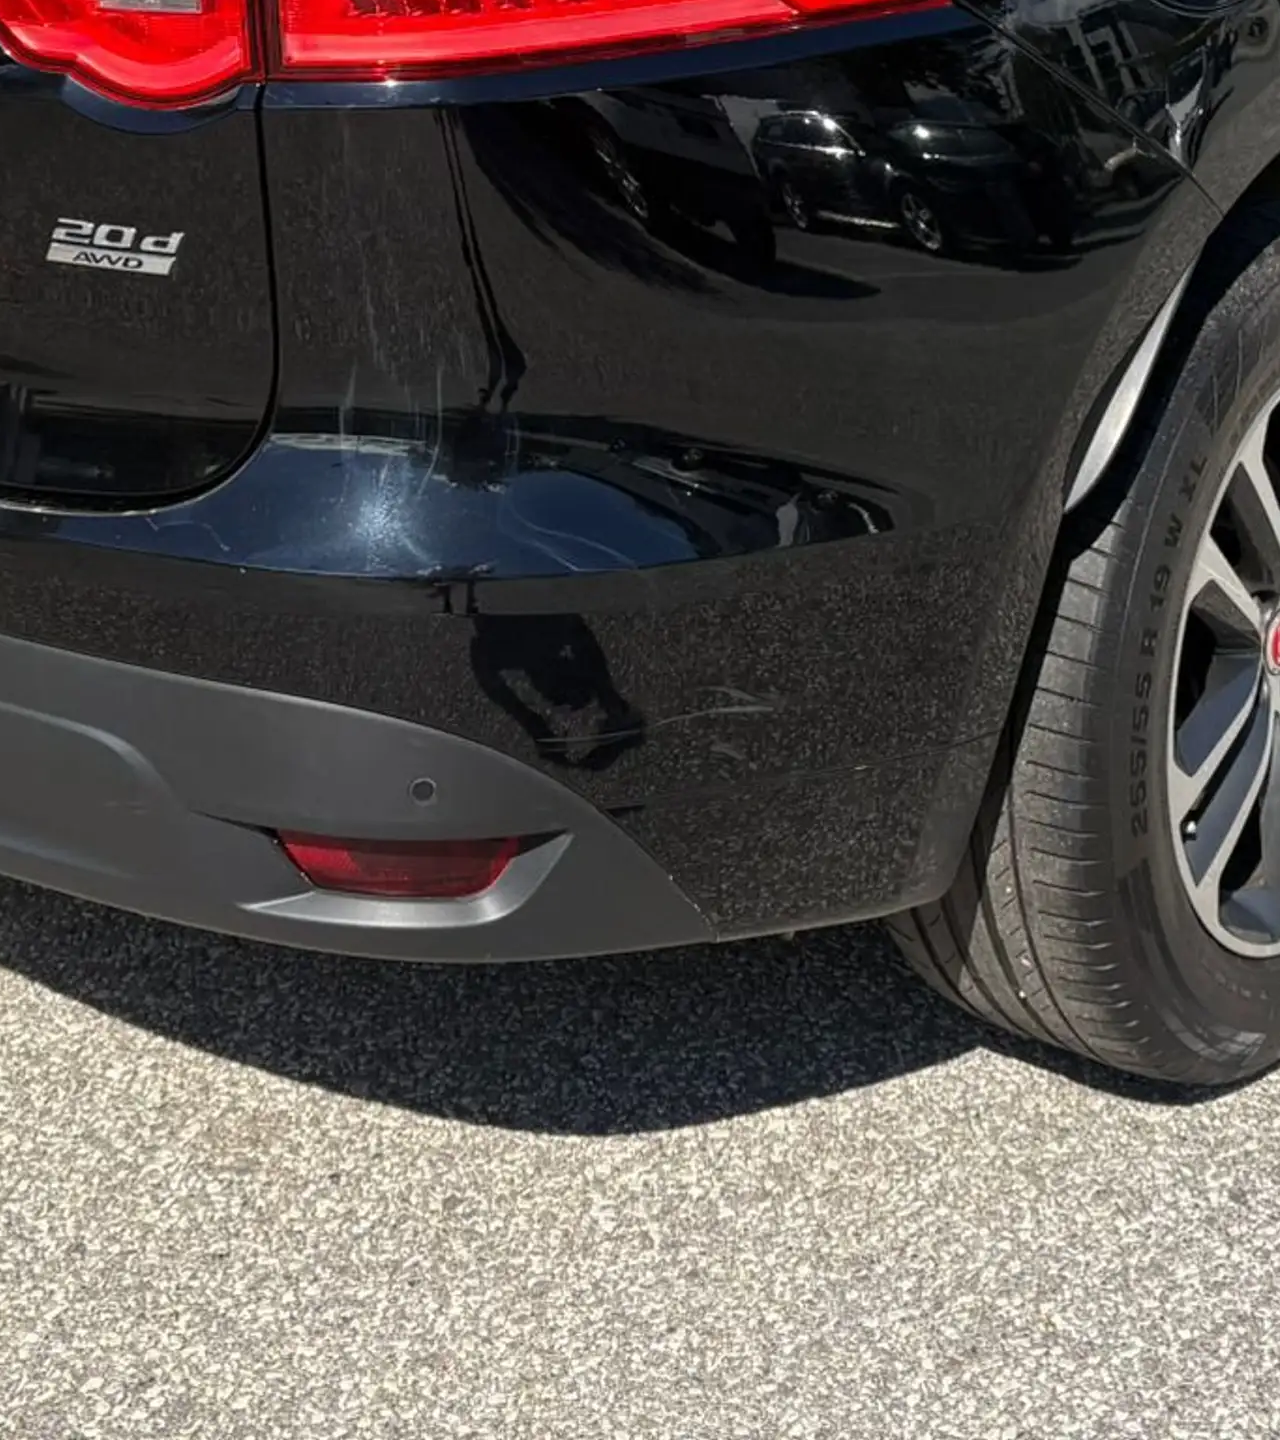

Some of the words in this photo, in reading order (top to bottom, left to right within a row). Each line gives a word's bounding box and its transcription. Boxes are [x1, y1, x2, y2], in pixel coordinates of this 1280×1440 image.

[52, 217, 185, 254] 20d
[72, 251, 143, 269] AWD
[1148, 564, 1172, 614] 19
[1139, 627, 1159, 657] R
[1129, 672, 1152, 838] 255/55
